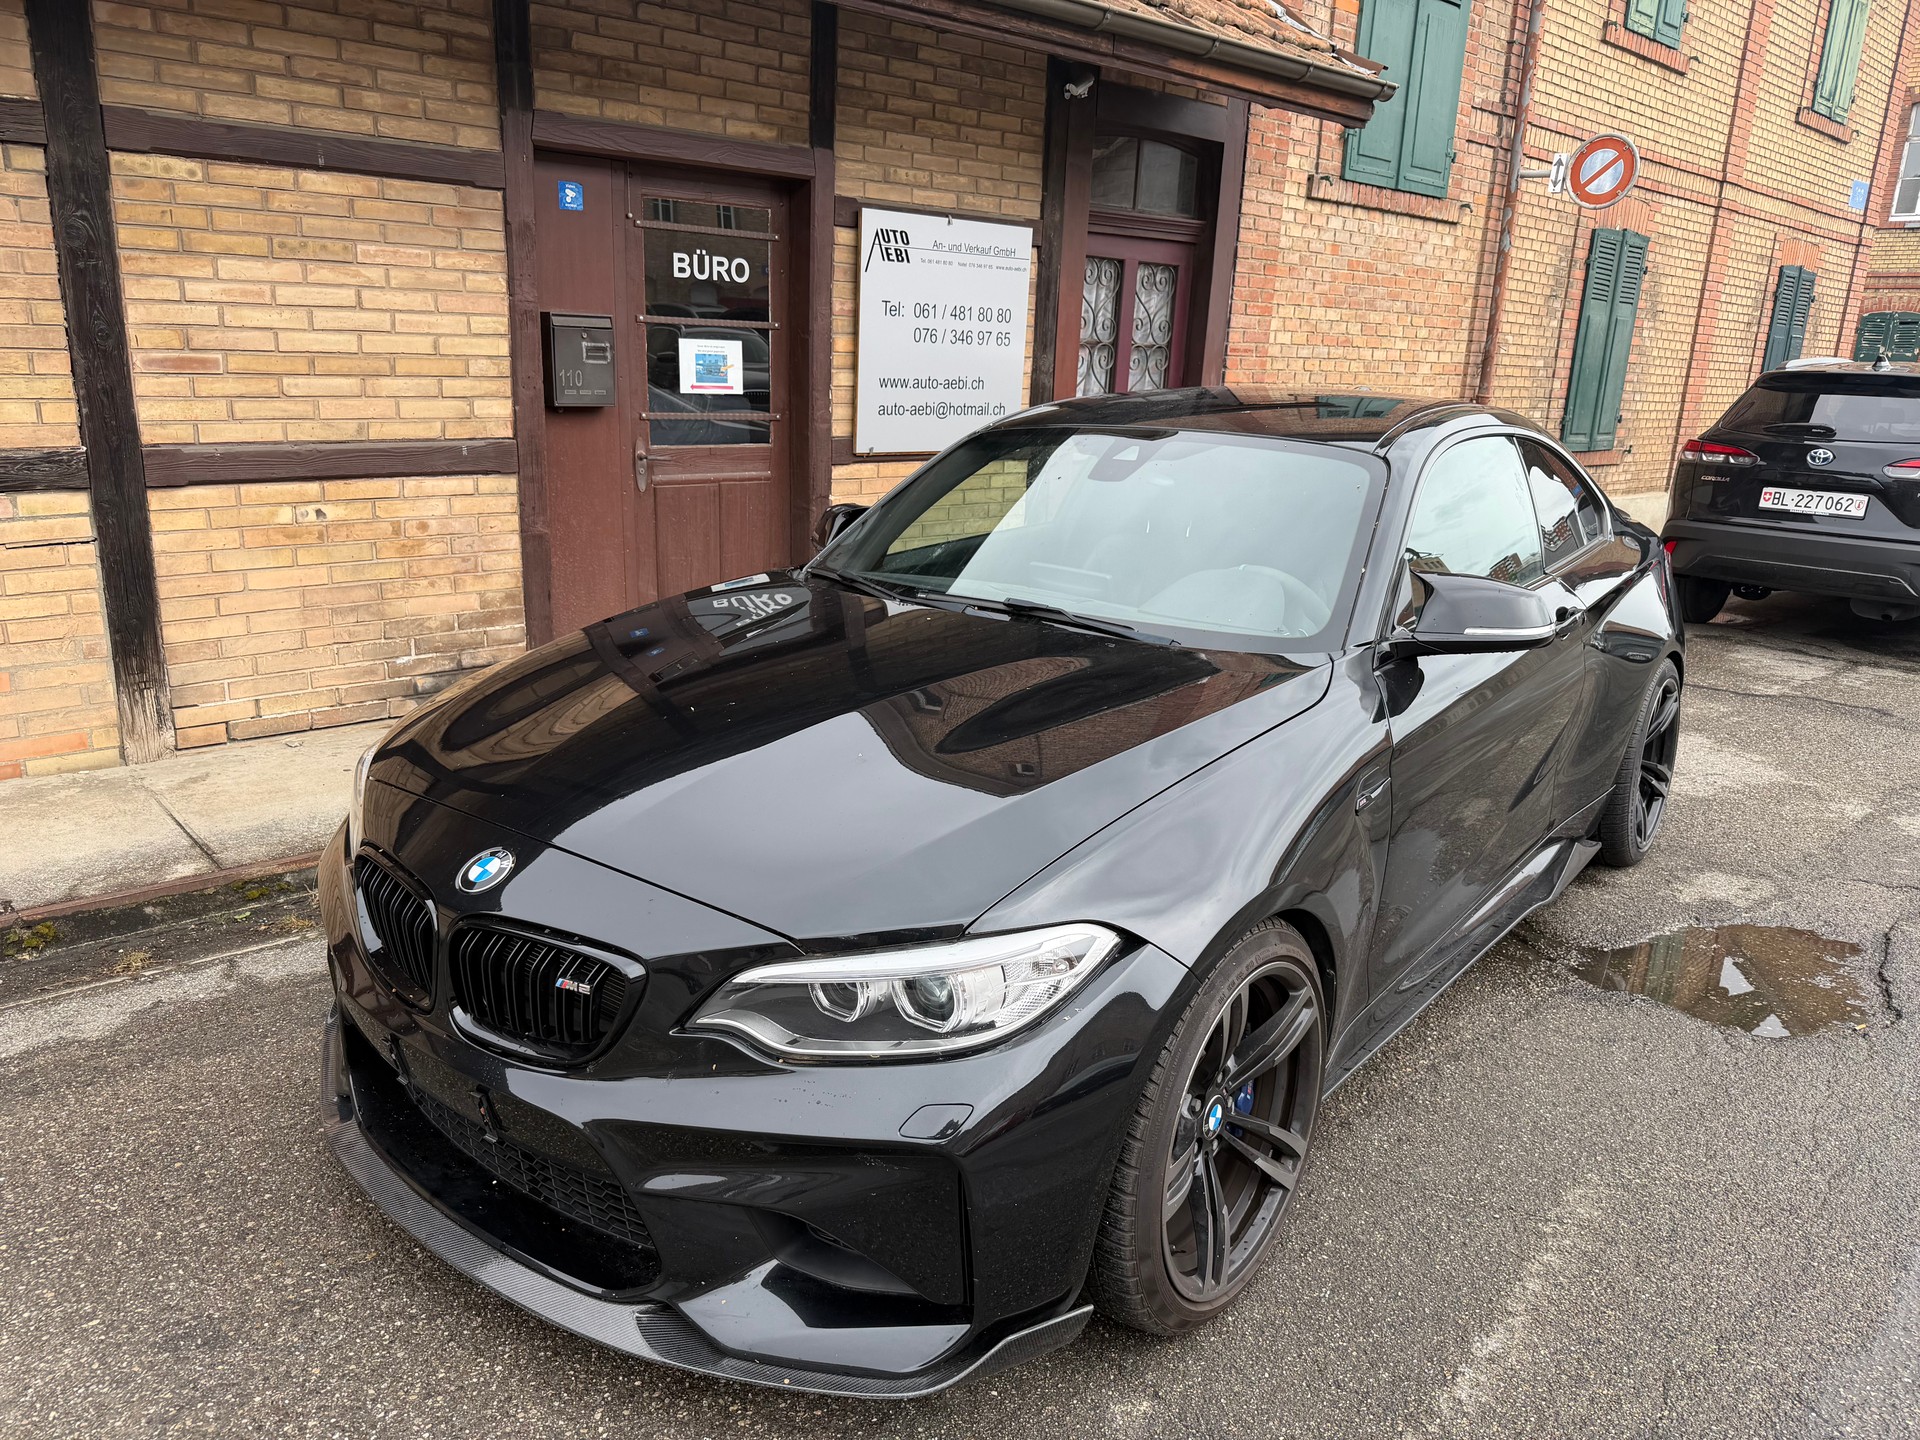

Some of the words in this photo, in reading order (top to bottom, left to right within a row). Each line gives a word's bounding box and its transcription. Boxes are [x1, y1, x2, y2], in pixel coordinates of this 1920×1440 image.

[932, 239, 946, 249] An-
[948, 243, 962, 252] und
[963, 243, 992, 255] Verkauf
[993, 246, 1016, 257] GmbH
[673, 249, 750, 283] BÜRO
[881, 300, 905, 317] Tel:
[913, 302, 937, 319] 061
[941, 304, 947, 320] /
[950, 305, 972, 321] 481
[977, 307, 993, 322] 80
[996, 308, 1012, 324] 80
[913, 327, 938, 344] 076
[941, 328, 947, 344] /
[950, 329, 974, 345] 346
[977, 331, 993, 346] 97
[996, 331, 1011, 347] 65
[560, 369, 583, 386] 110
[878, 375, 985, 390] www.auto-aebi.ch
[878, 401, 1006, 419] auto-aebi@hotmail.ch
